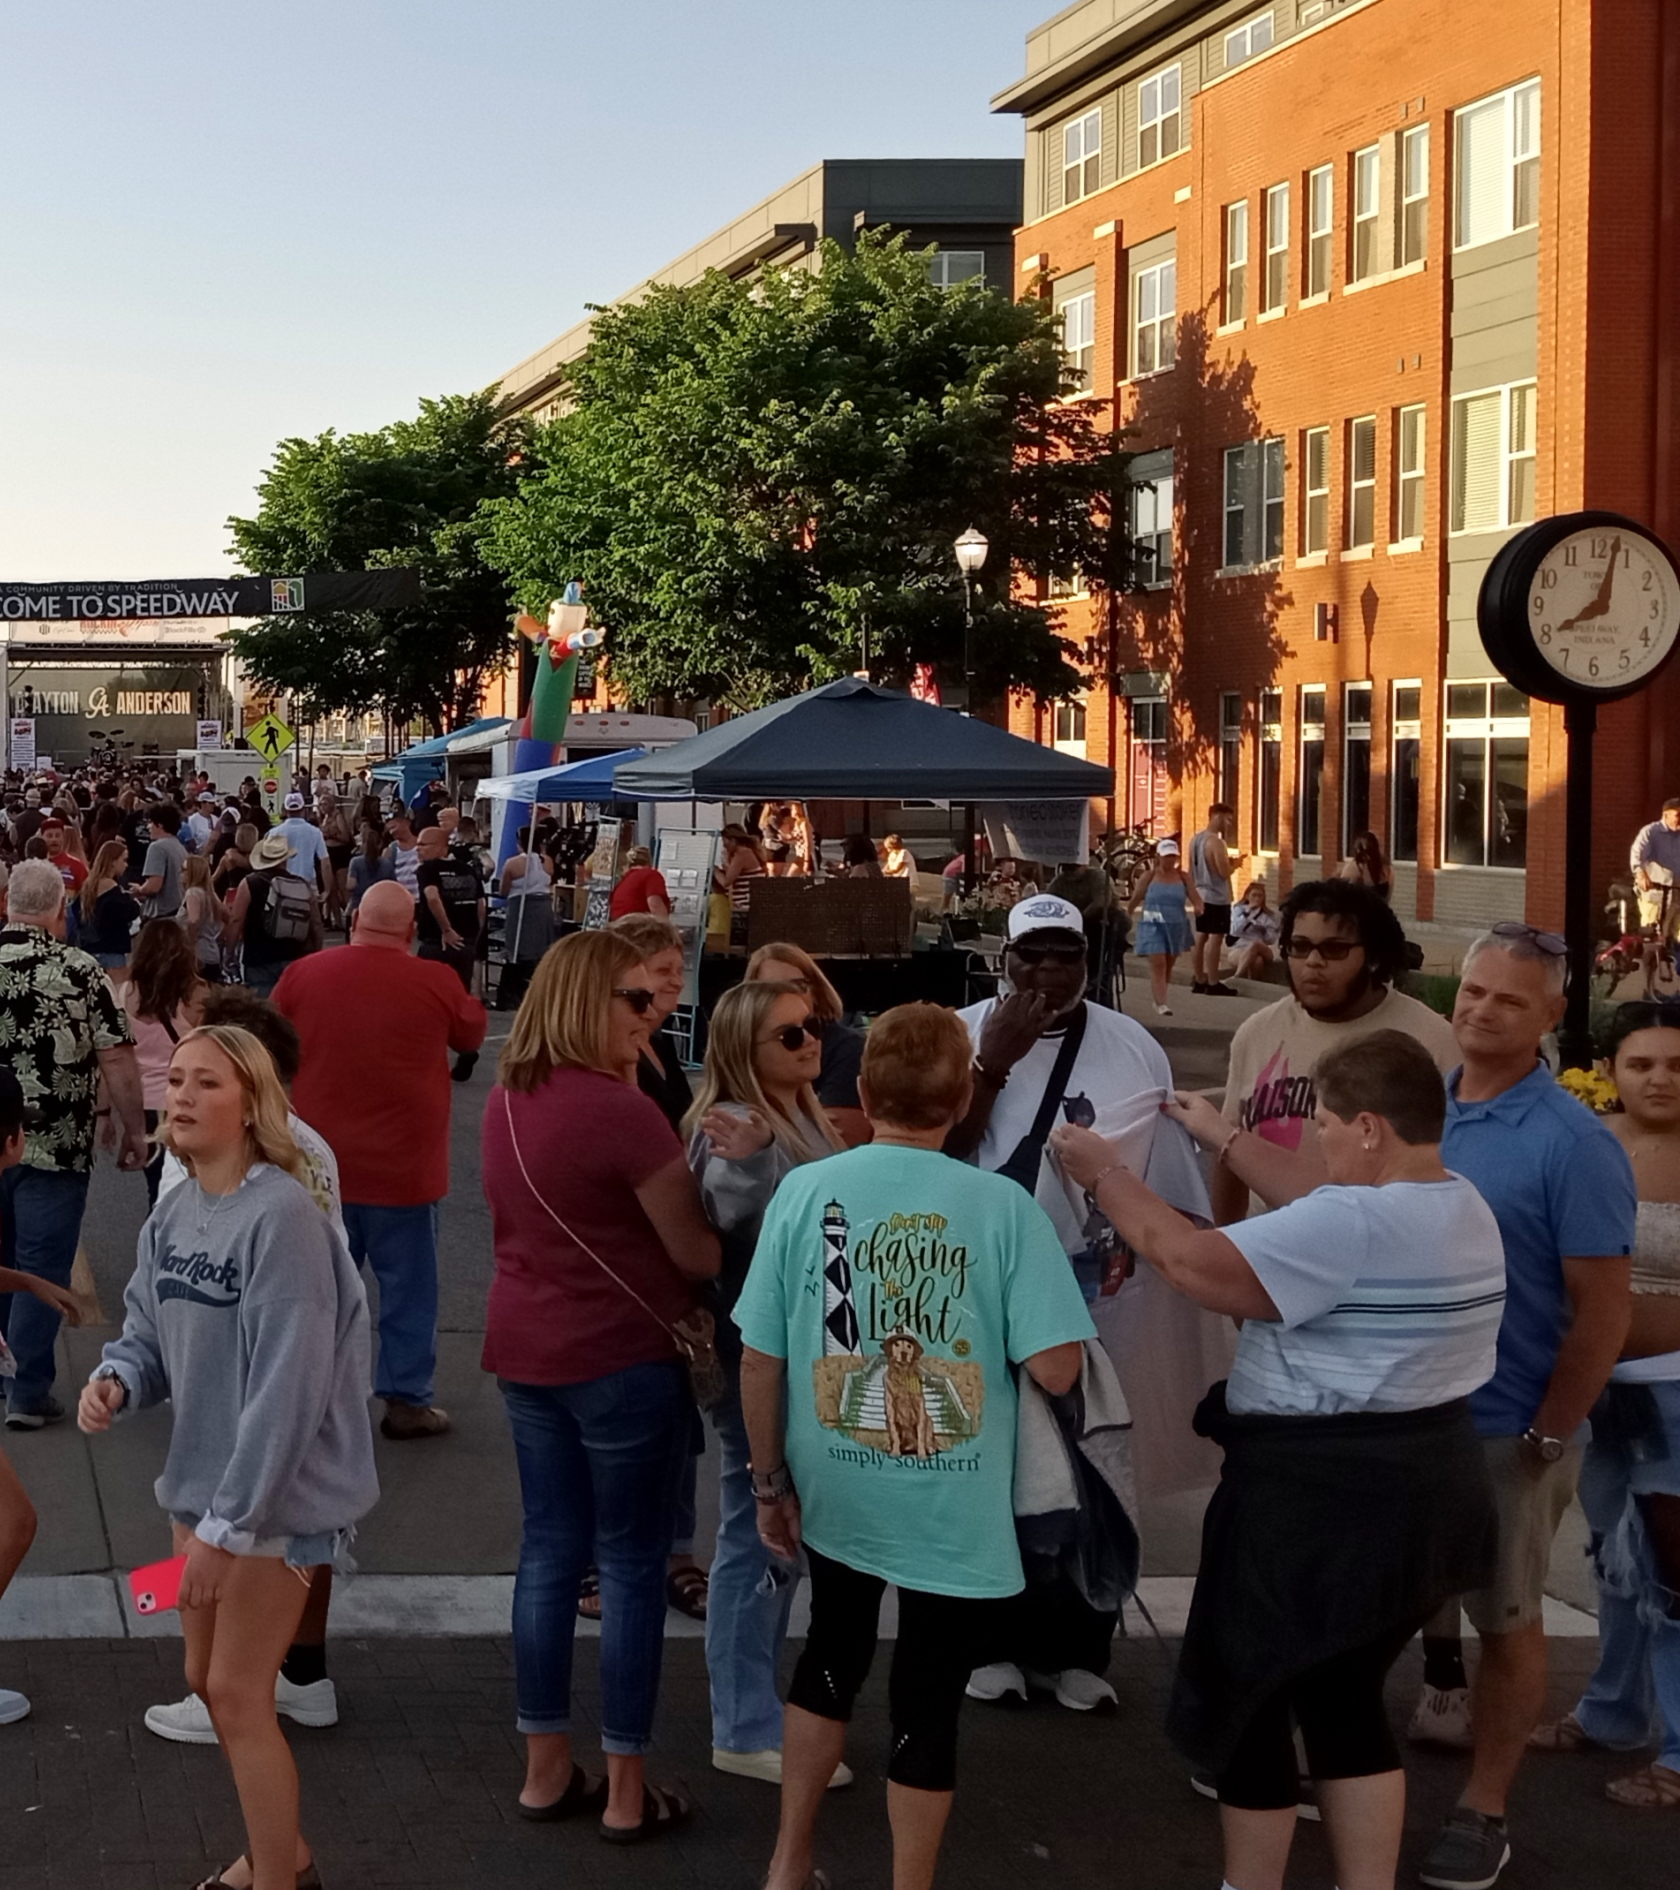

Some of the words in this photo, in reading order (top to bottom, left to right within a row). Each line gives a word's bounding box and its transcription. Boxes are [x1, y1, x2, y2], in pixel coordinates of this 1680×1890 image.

[1564, 545, 1578, 567] 11
[1590, 538, 1608, 560] 12
[1624, 548, 1631, 569] 1
[4, 585, 66, 593] COMMUNITY
[67, 584, 106, 593] DRIVEN
[107, 584, 121, 592] BY
[124, 583, 178, 592] TRADITION
[1539, 568, 1558, 590] 10
[1642, 570, 1653, 592] 2
[70, 595, 104, 618] TO
[107, 591, 240, 617] SPEEDWAY
[1533, 596, 1545, 616] 9
[1649, 599, 1660, 620] 3
[1540, 623, 1552, 645] 8
[1639, 626, 1651, 648] 4
[1559, 648, 1570, 670] 7
[1589, 656, 1599, 677] 6
[1618, 649, 1631, 670] 5
[116, 691, 191, 715] ANDERSON
[853, 1222, 979, 1299] chasing
[186, 1251, 241, 1293] Rock
[867, 1276, 962, 1345] Light
[827, 1444, 885, 1471] simply
[895, 1449, 980, 1472] southern
